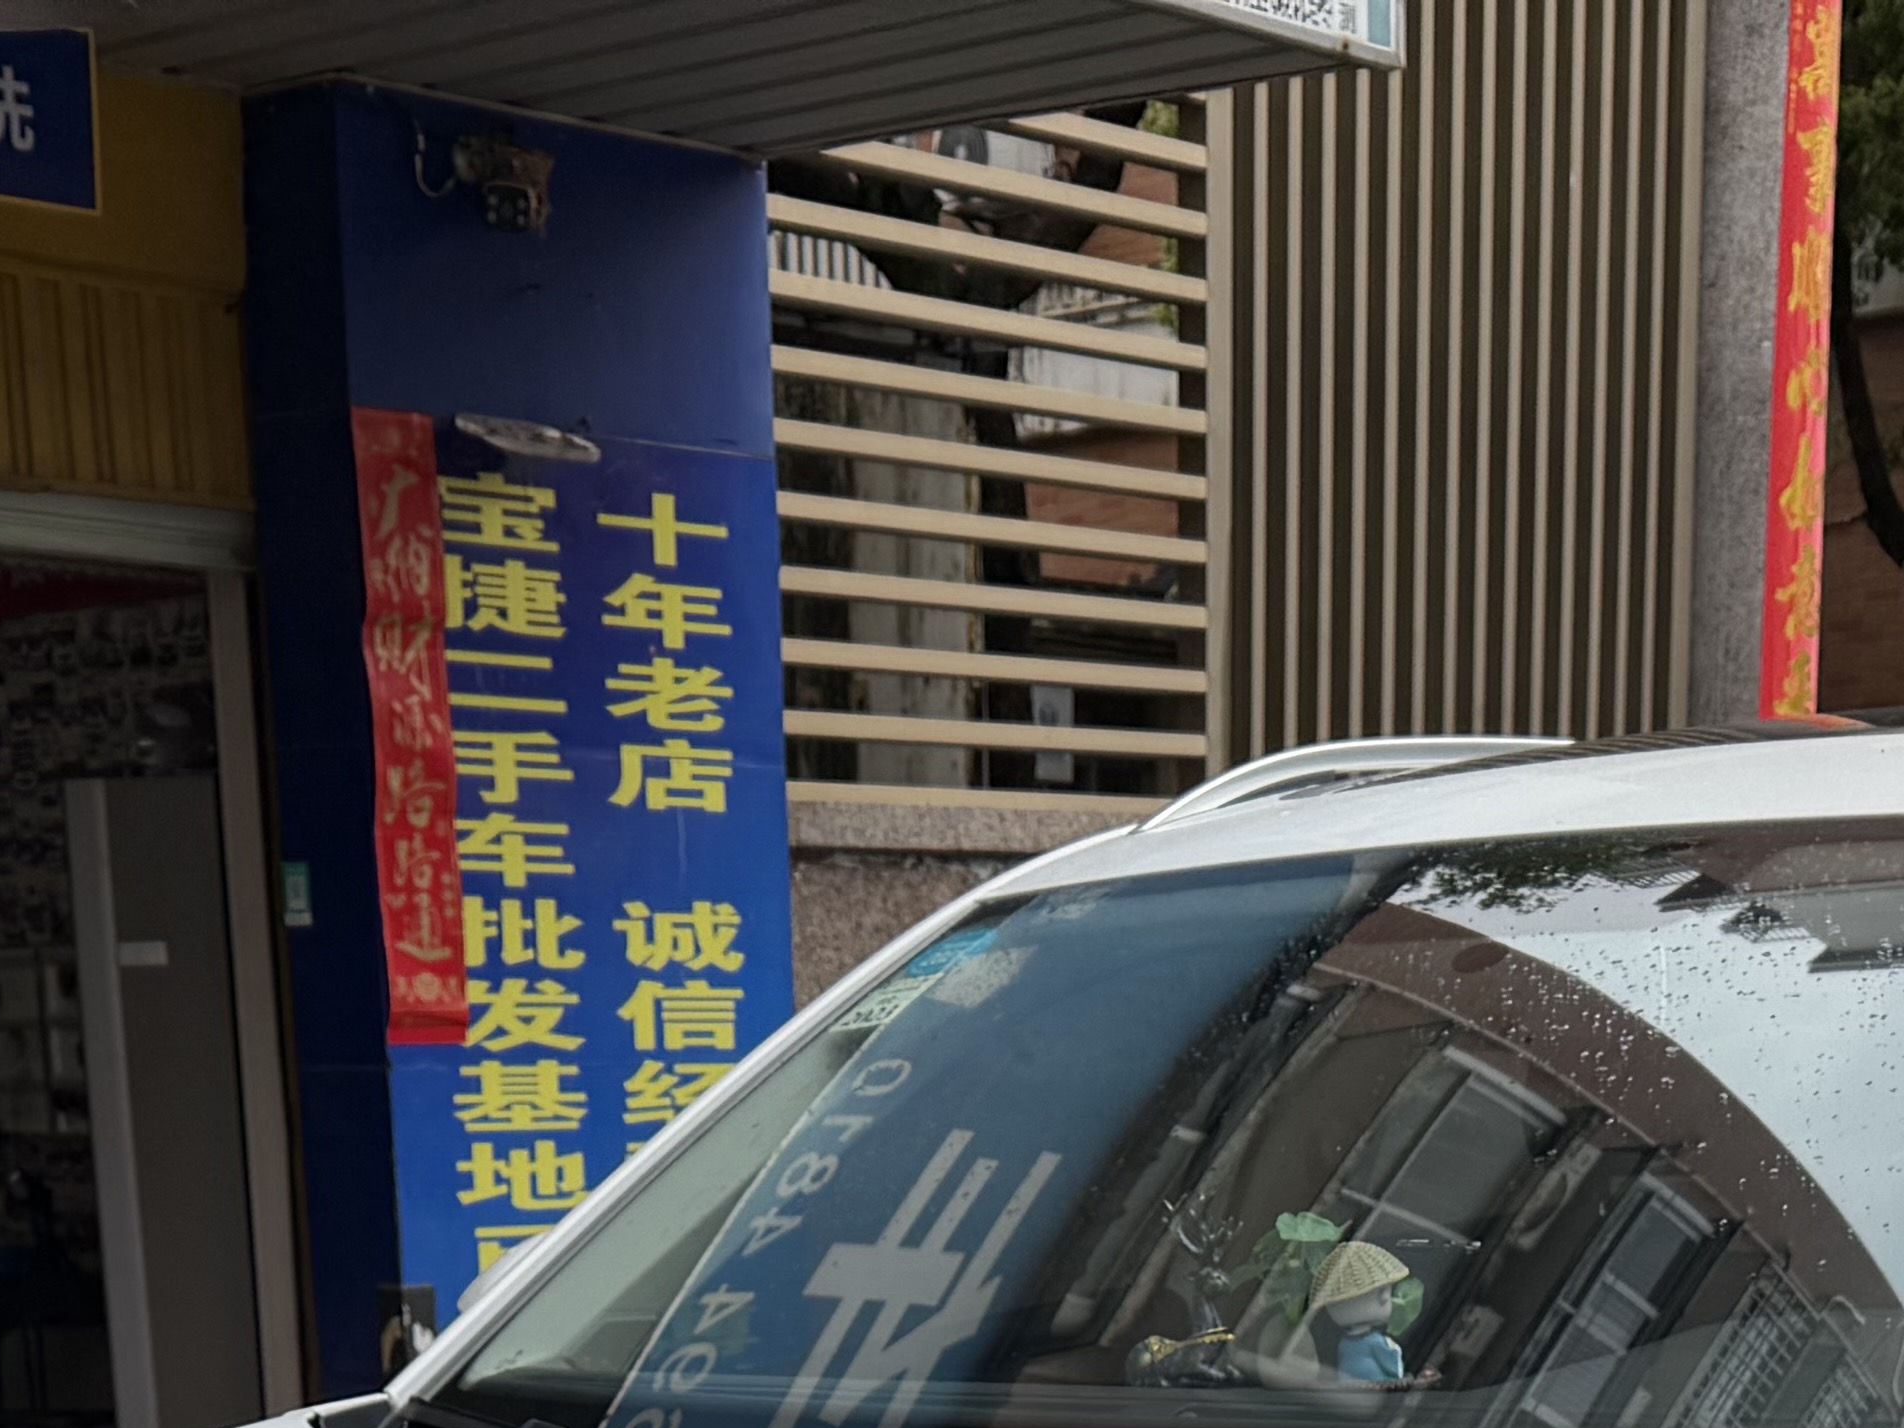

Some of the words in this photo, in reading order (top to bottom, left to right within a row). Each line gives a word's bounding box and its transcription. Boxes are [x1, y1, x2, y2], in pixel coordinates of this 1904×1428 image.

[596, 492, 734, 813] 十年老店
[612, 900, 746, 1162] 诚信经
